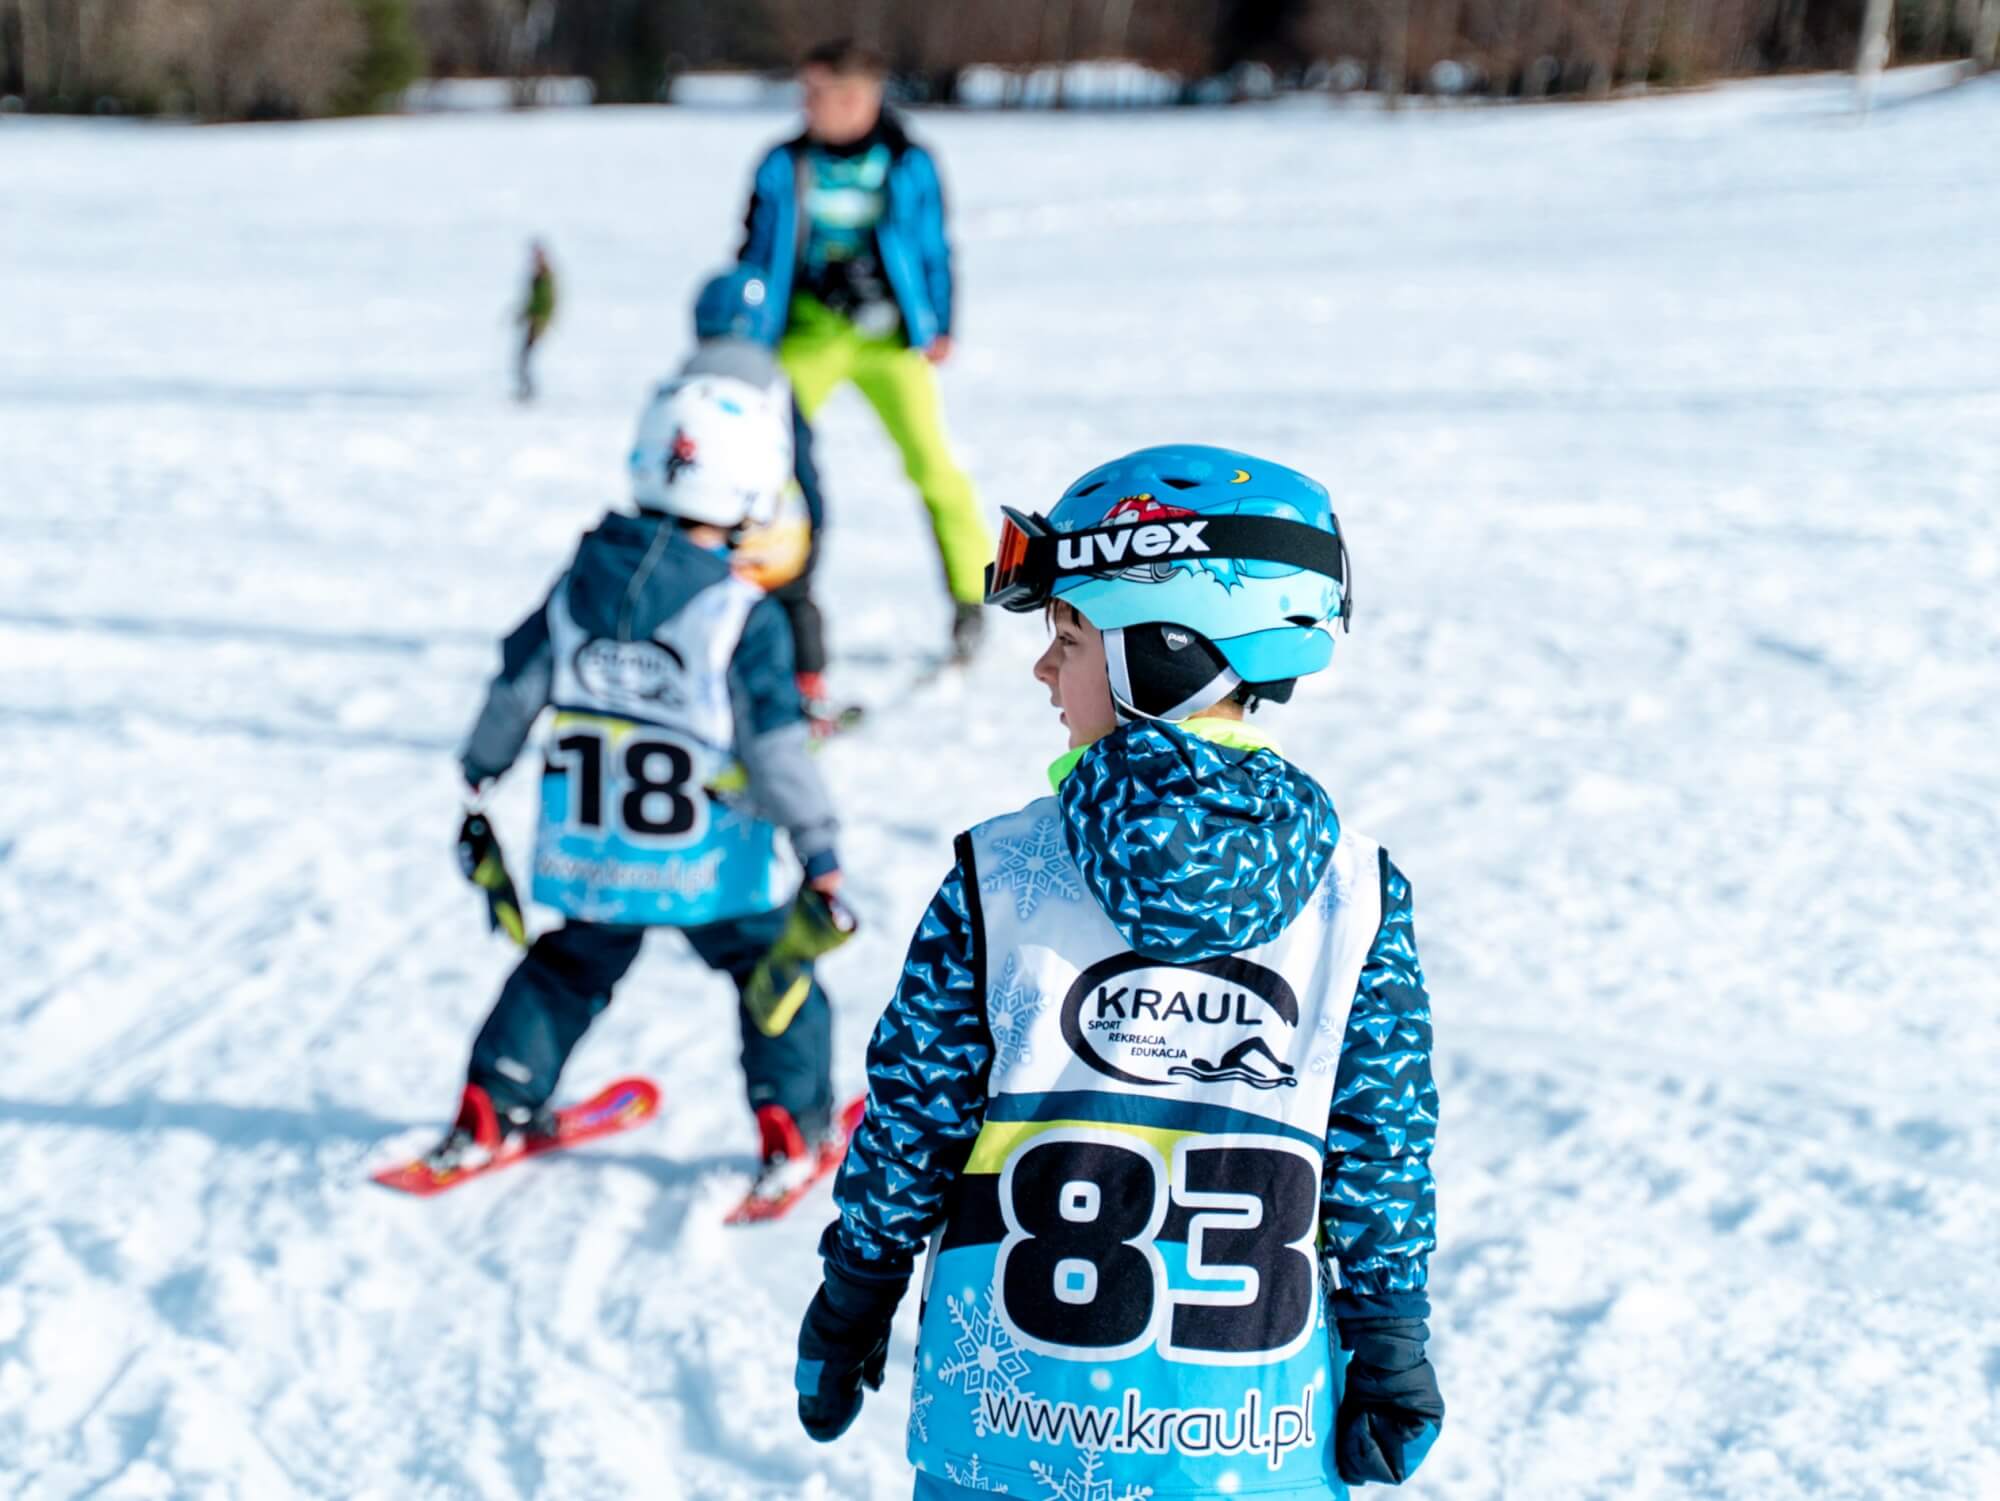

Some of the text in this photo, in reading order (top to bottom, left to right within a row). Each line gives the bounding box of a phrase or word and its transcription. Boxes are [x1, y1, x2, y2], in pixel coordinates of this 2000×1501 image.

[1056, 520, 1211, 569] uvex
[558, 735, 695, 835] 18
[1088, 1020, 1121, 1031] SPORT
[1096, 986, 1263, 1025] KRAUL
[1108, 1032, 1166, 1046] REKREACJA
[1130, 1046, 1188, 1059] EDUKACJA
[1002, 1139, 1318, 1354] 83
[984, 1389, 1314, 1465] www.kraul.pl
